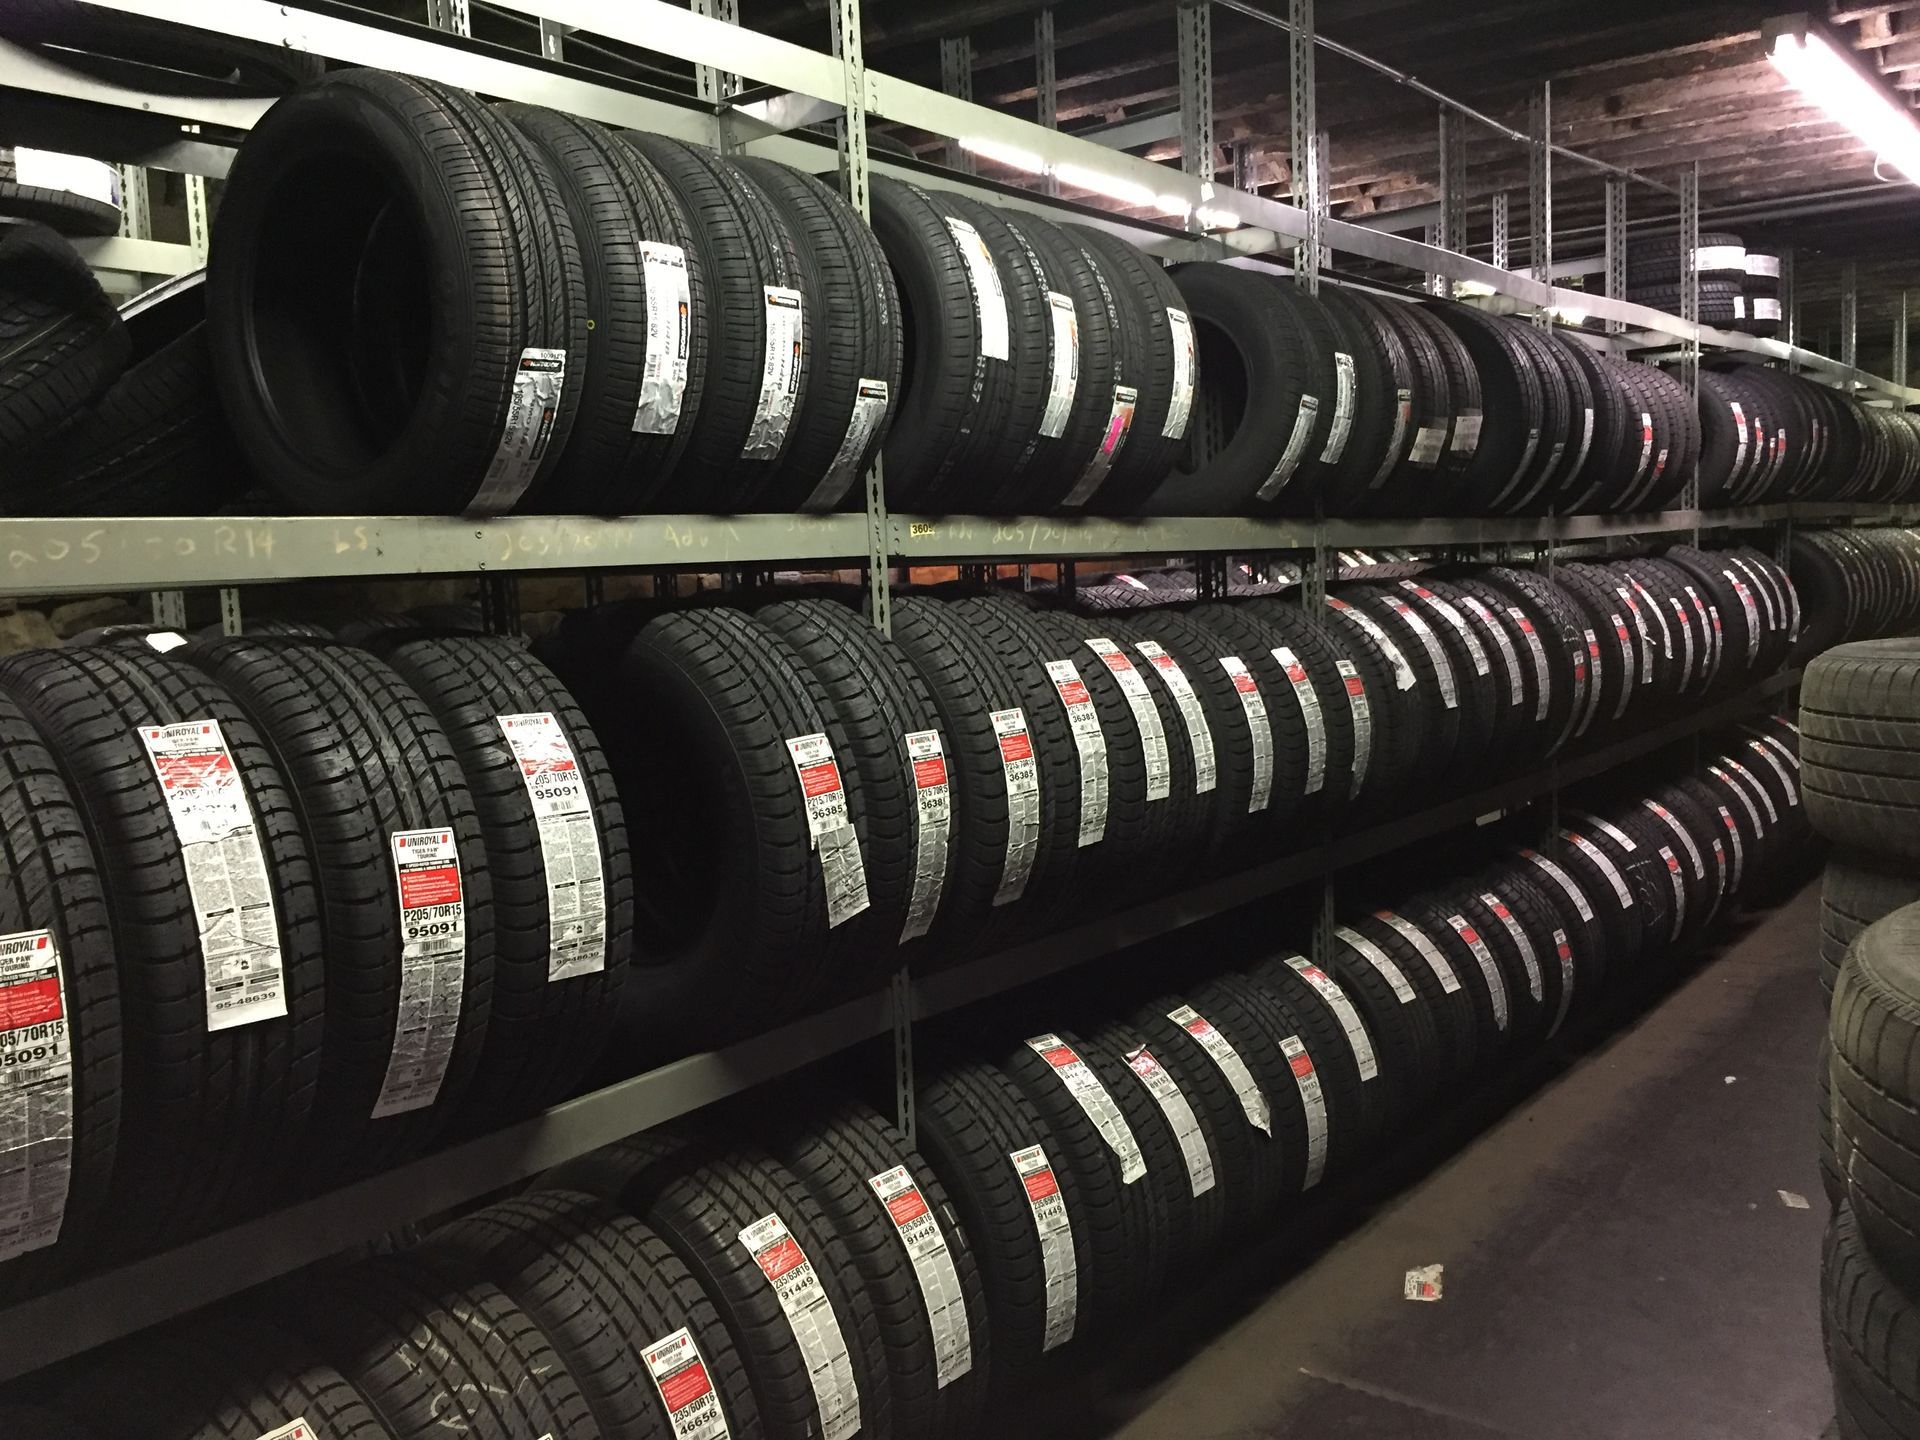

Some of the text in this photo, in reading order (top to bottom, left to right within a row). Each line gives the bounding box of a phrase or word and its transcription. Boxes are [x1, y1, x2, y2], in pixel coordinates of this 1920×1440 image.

[161, 726, 200, 740] UNIROYAL
[527, 770, 579, 786] 205/70R15
[535, 785, 579, 800] 95091
[812, 804, 844, 820] 36385
[407, 835, 440, 848] UNIROYAL
[403, 903, 462, 922] P205/70R15
[408, 921, 458, 939] 95091
[215, 991, 276, 1011] 95-48639
[0, 1020, 64, 1048] 05/70R15
[0, 1042, 60, 1068] 5091
[1037, 1205, 1063, 1221] 91449
[907, 1225, 936, 1245] 91449
[773, 1262, 811, 1290] 235/65R16
[781, 1276, 814, 1300] 91449
[672, 1391, 716, 1424] 235/60R16
[679, 1408, 717, 1436] 46656
